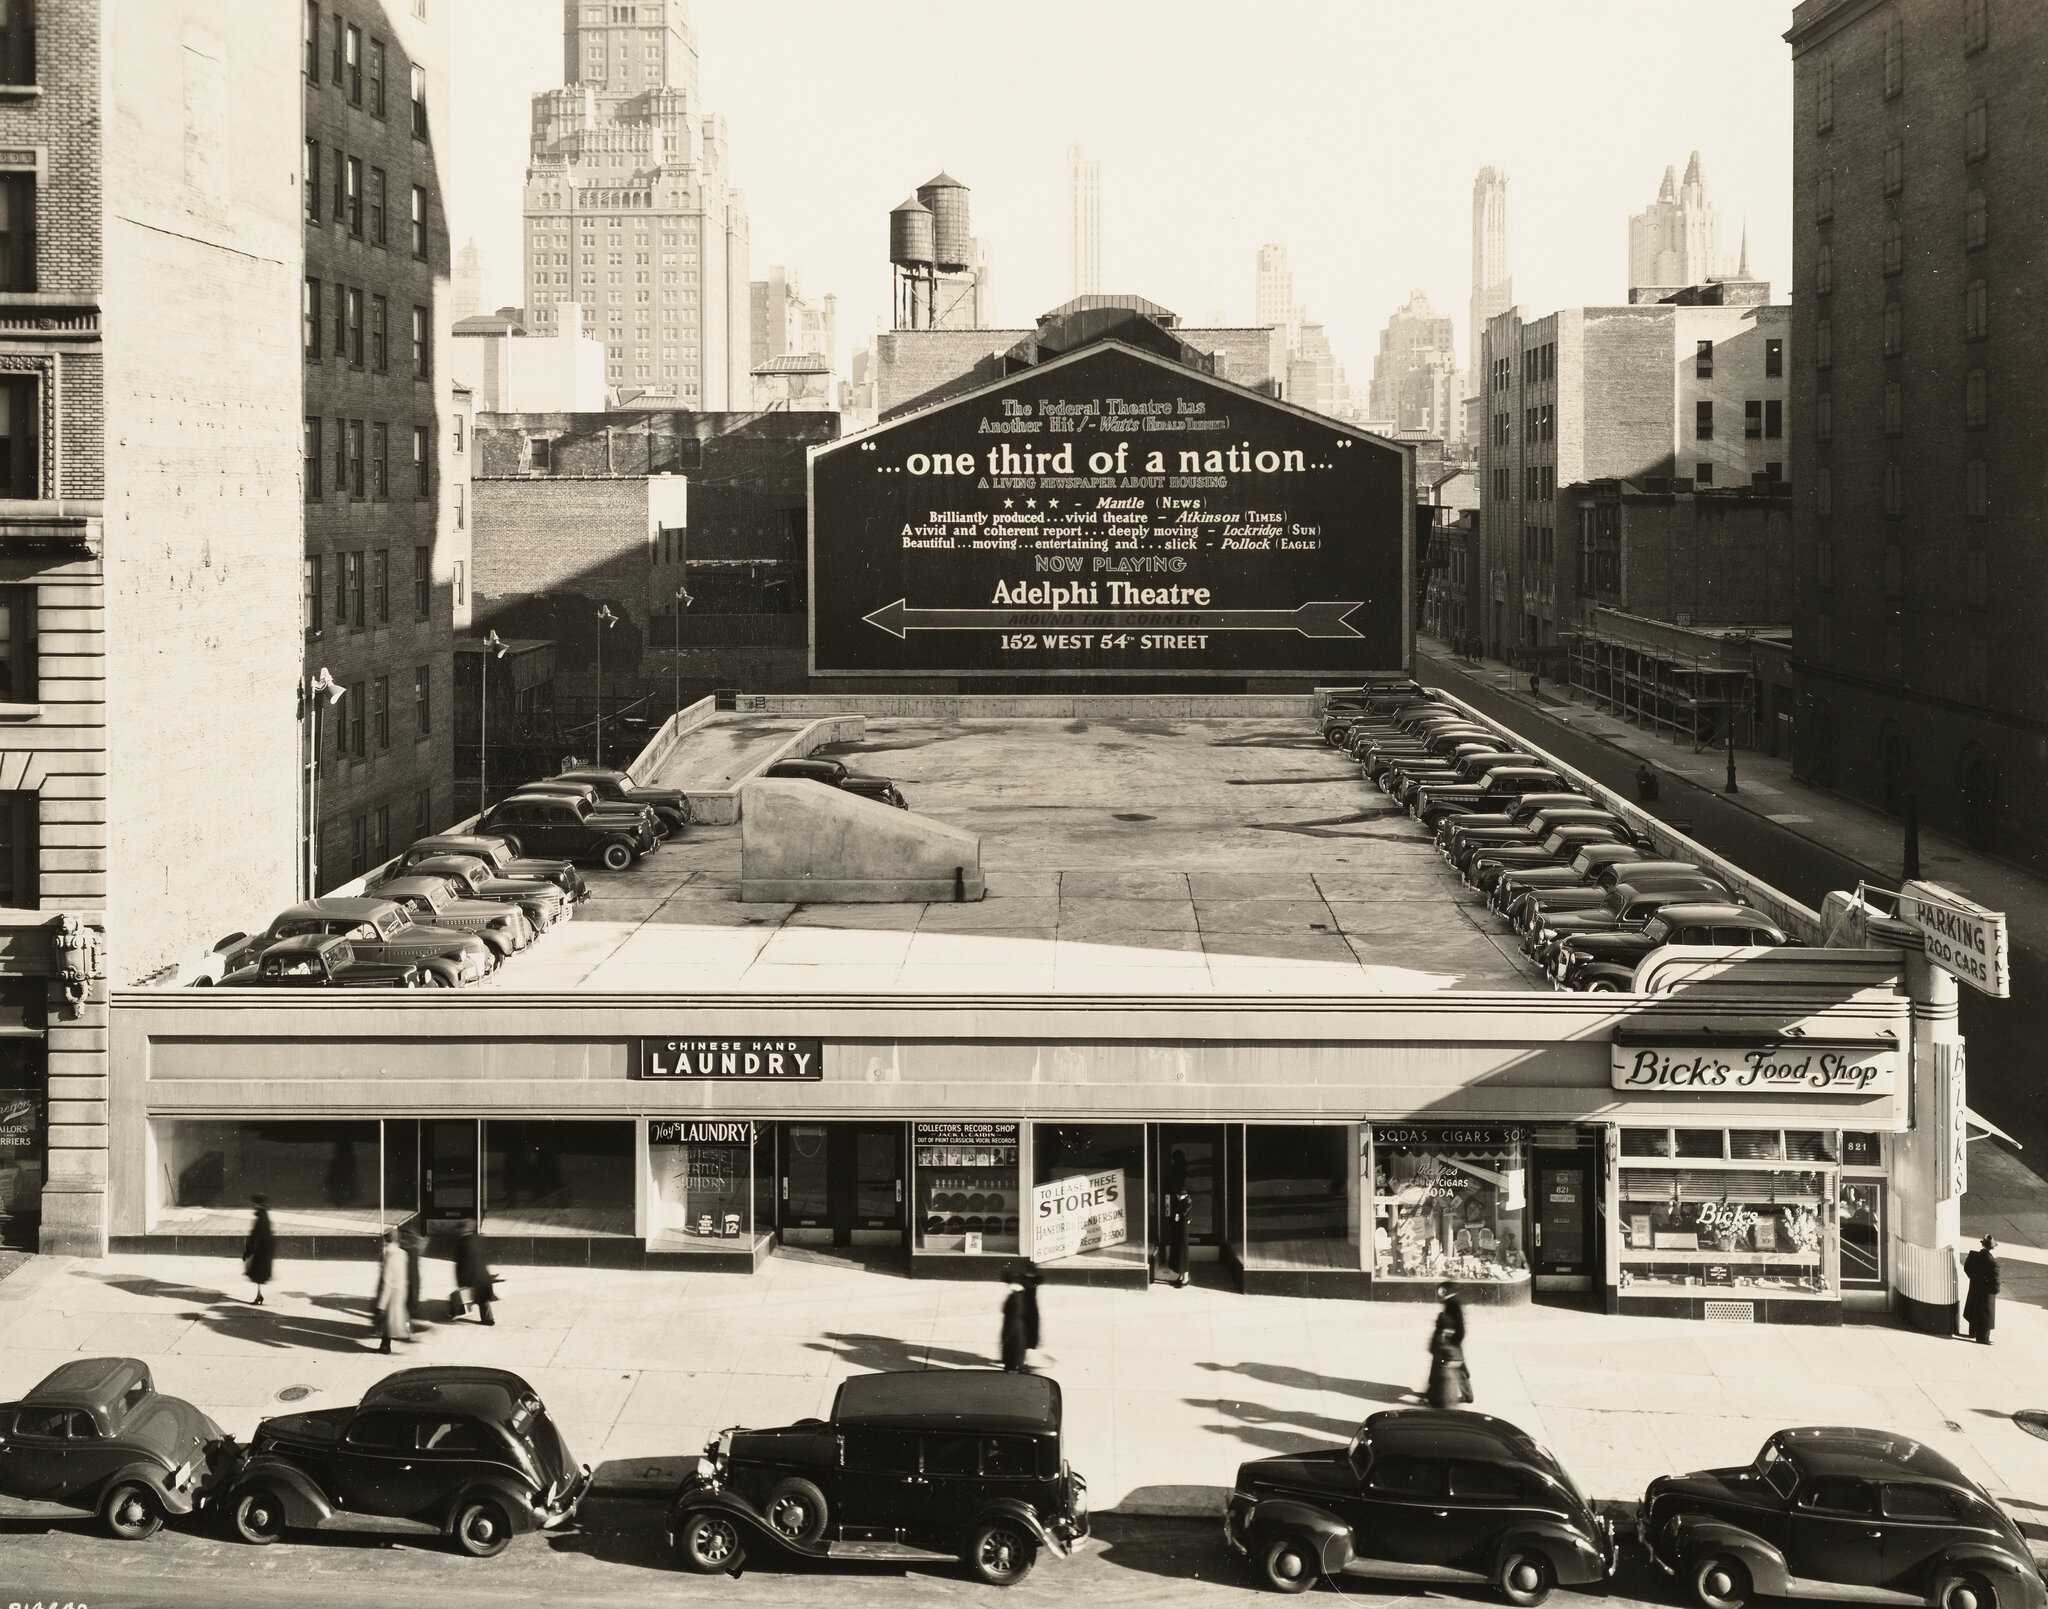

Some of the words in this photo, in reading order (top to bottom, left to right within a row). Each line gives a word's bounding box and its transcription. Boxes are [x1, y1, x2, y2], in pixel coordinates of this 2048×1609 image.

[1002, 399, 1033, 416] The
[1039, 399, 1100, 416] Federal
[1106, 398, 1173, 415] Theatre
[1177, 398, 1206, 415] has
[978, 416, 1043, 433] Another
[1099, 416, 1140, 432] Watts
[987, 443, 1074, 476] third
[1088, 442, 1129, 475] of
[1145, 450, 1166, 474] a
[978, 478, 989, 489] A
[993, 477, 1036, 489] LIVING
[1040, 477, 1117, 489] NEWSPAPER
[1120, 477, 1166, 488] ABOUT
[1169, 477, 1228, 488] HOUSING
[1096, 496, 1145, 509] Mantle
[1156, 496, 1207, 510] (NEWS)
[929, 511, 989, 525] Brilliantly
[1102, 512, 1148, 523] theatre
[1175, 511, 1240, 523] Atkinson
[1244, 510, 1288, 523] (TIMES)
[901, 524, 913, 536] A
[915, 524, 947, 536] vivid
[953, 524, 977, 536] and
[983, 524, 1039, 536] coherent
[1108, 525, 1150, 539] deeply
[1153, 525, 1198, 538] moving
[1223, 525, 1283, 538] Lockridge
[1287, 524, 1321, 537] (SUN)
[1035, 538, 1109, 551] entertaining
[1164, 538, 1198, 550] slick
[1221, 538, 1270, 550] Pollock
[1275, 538, 1321, 550] (EAGLE)
[1034, 554, 1084, 573] NOW
[1093, 555, 1187, 573] PLAYING
[992, 579, 1099, 610] Adelphi
[1106, 581, 1211, 605] Theatre
[1008, 614, 1075, 626] AROUND
[1082, 614, 1117, 626] THE
[1126, 614, 1201, 626] CORNER
[1001, 634, 1038, 650] 152
[1042, 635, 1095, 650] WEST
[1140, 634, 1209, 650] STREET
[1916, 902, 1986, 956] PARKING
[1927, 935, 1952, 962] 200
[1955, 950, 1987, 981] CARS
[667, 1042, 742, 1051] CHINESE
[752, 1042, 797, 1051] HAND
[652, 1052, 811, 1075] LAUNDRY
[1625, 1050, 1731, 1086] Bick's
[1735, 1050, 1812, 1087] Food
[1811, 1053, 1878, 1090] Shop
[680, 1123, 749, 1141] LAUNDRY
[964, 1124, 993, 1132] RECORD
[995, 1124, 1015, 1132] SHOP
[1379, 1130, 1428, 1142] SODAS
[1442, 1130, 1490, 1142] CIGARS
[1848, 1142, 1866, 1151] 821
[1040, 1189, 1052, 1199] TO
[1055, 1182, 1084, 1197] LEASE
[1089, 1174, 1117, 1188] THESE
[1039, 1185, 1119, 1218] STORES
[1696, 1202, 1759, 1225] Bick's
